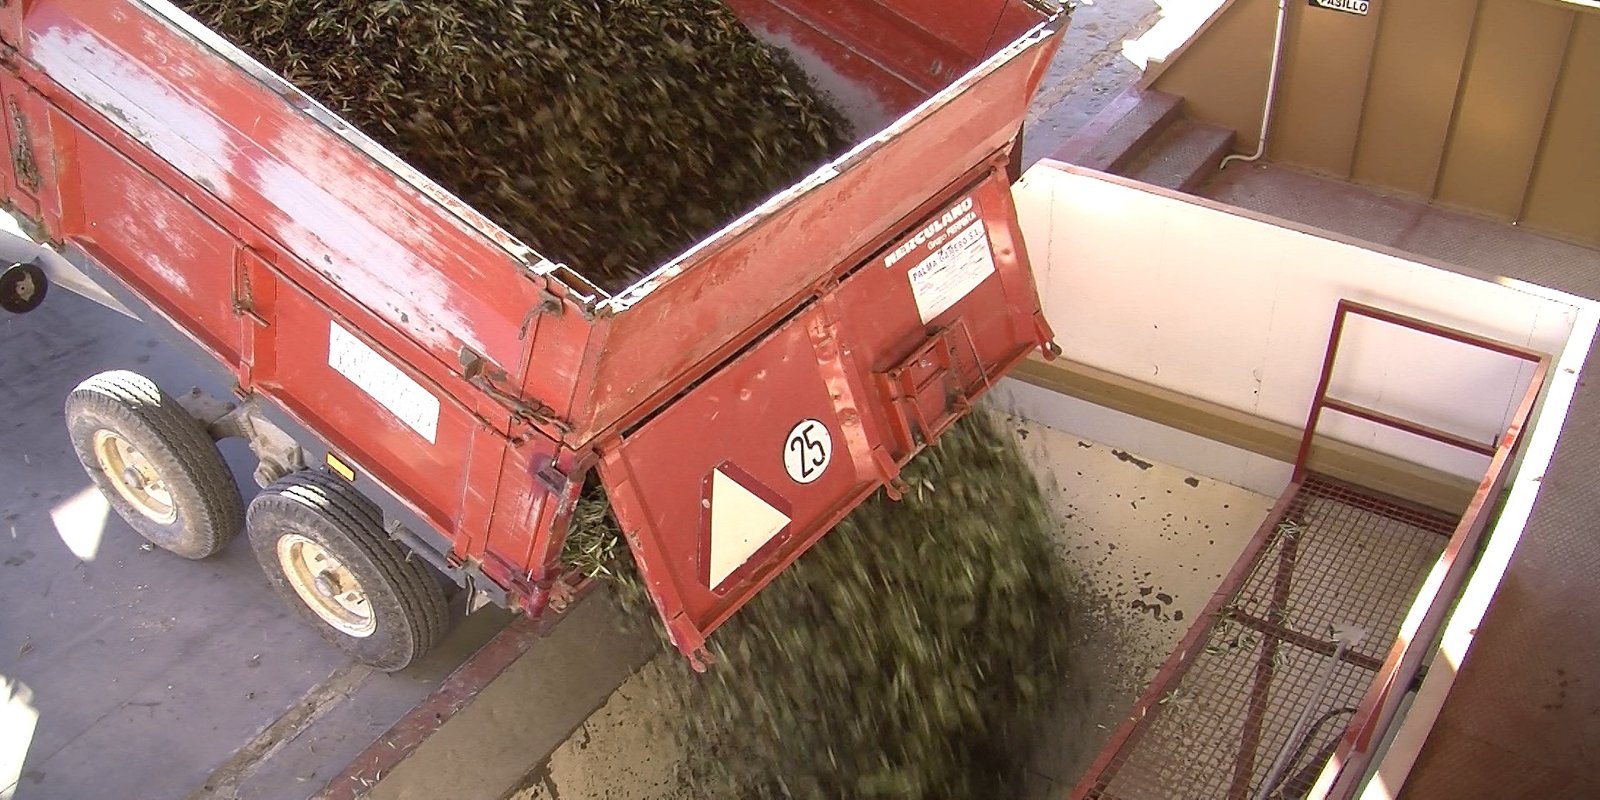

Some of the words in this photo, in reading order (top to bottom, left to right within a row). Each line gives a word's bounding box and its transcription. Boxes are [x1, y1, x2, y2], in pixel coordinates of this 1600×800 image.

[1321, 0, 1368, 12] ASILLO
[884, 197, 973, 269] HERCULANO
[912, 260, 938, 282] PALMA
[790, 424, 826, 478] 25
